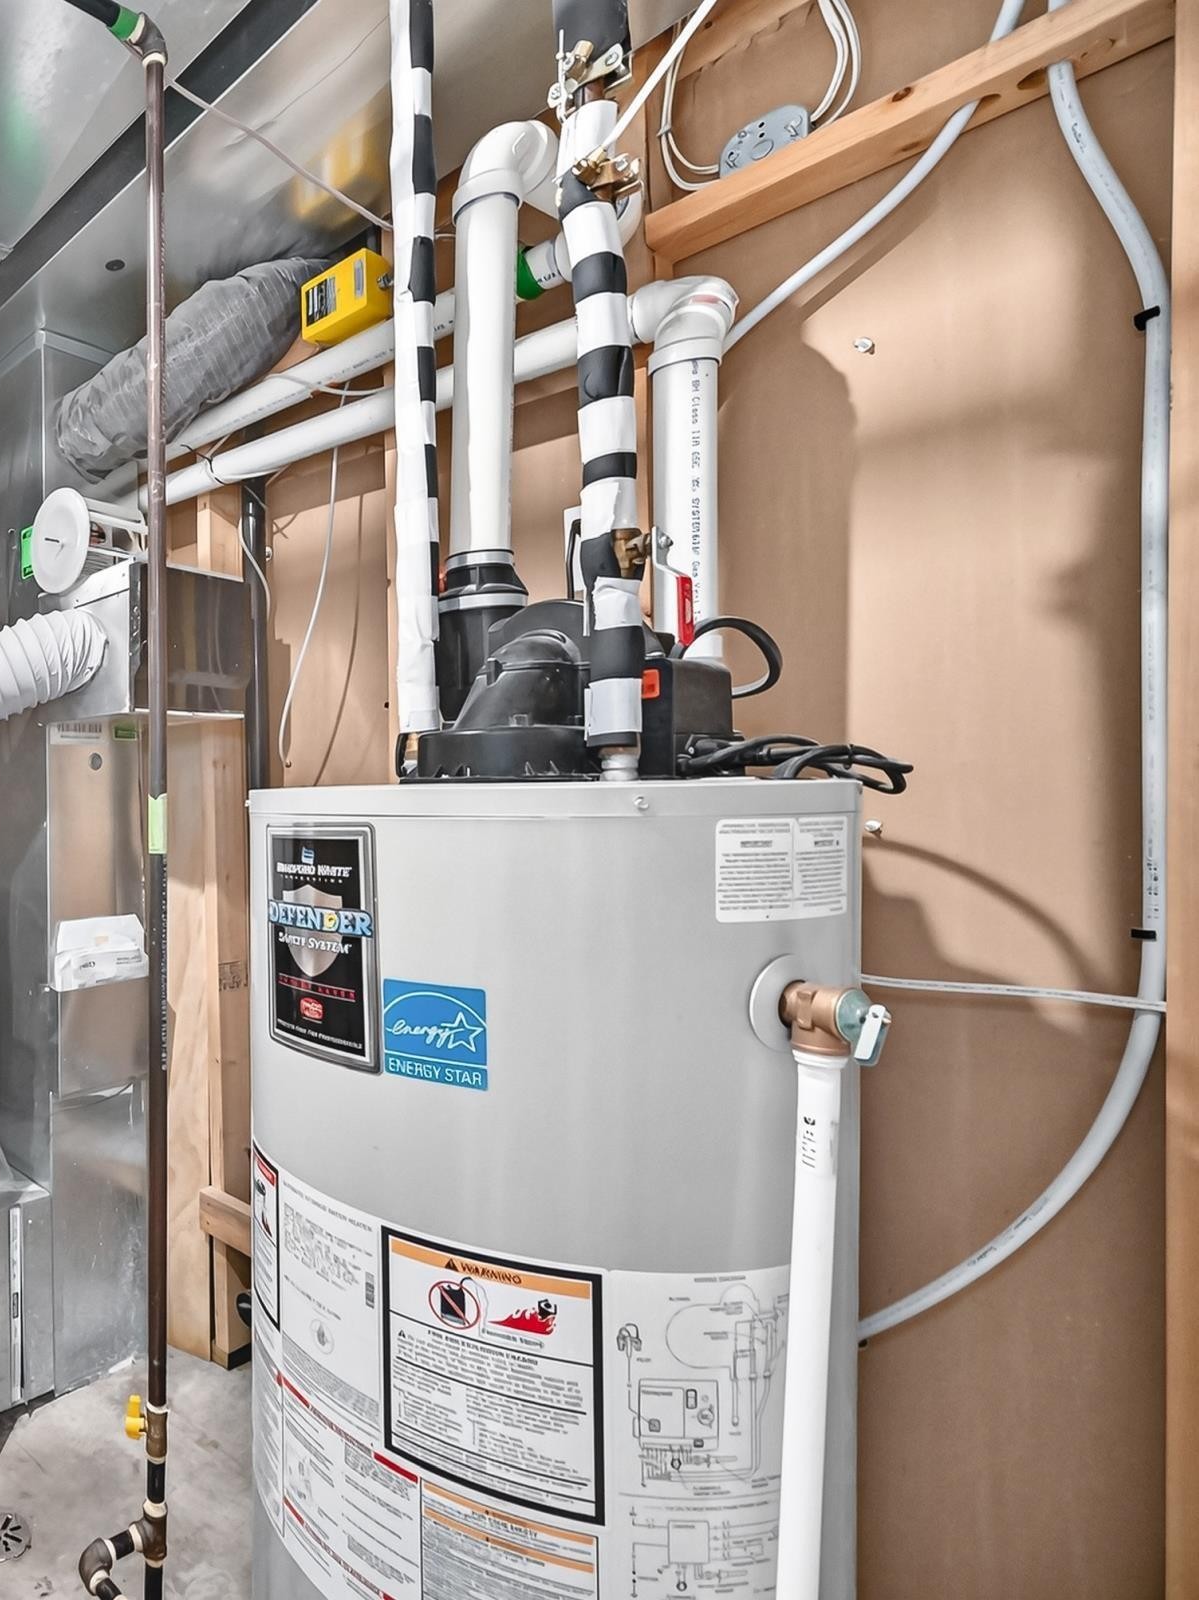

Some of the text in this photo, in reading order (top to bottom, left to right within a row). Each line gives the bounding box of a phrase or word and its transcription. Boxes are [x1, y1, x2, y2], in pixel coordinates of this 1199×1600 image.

[268, 900, 373, 937] DEFENDER
[388, 1057, 482, 1086] ENERGY STAR
[459, 1261, 522, 1285] WARNING
